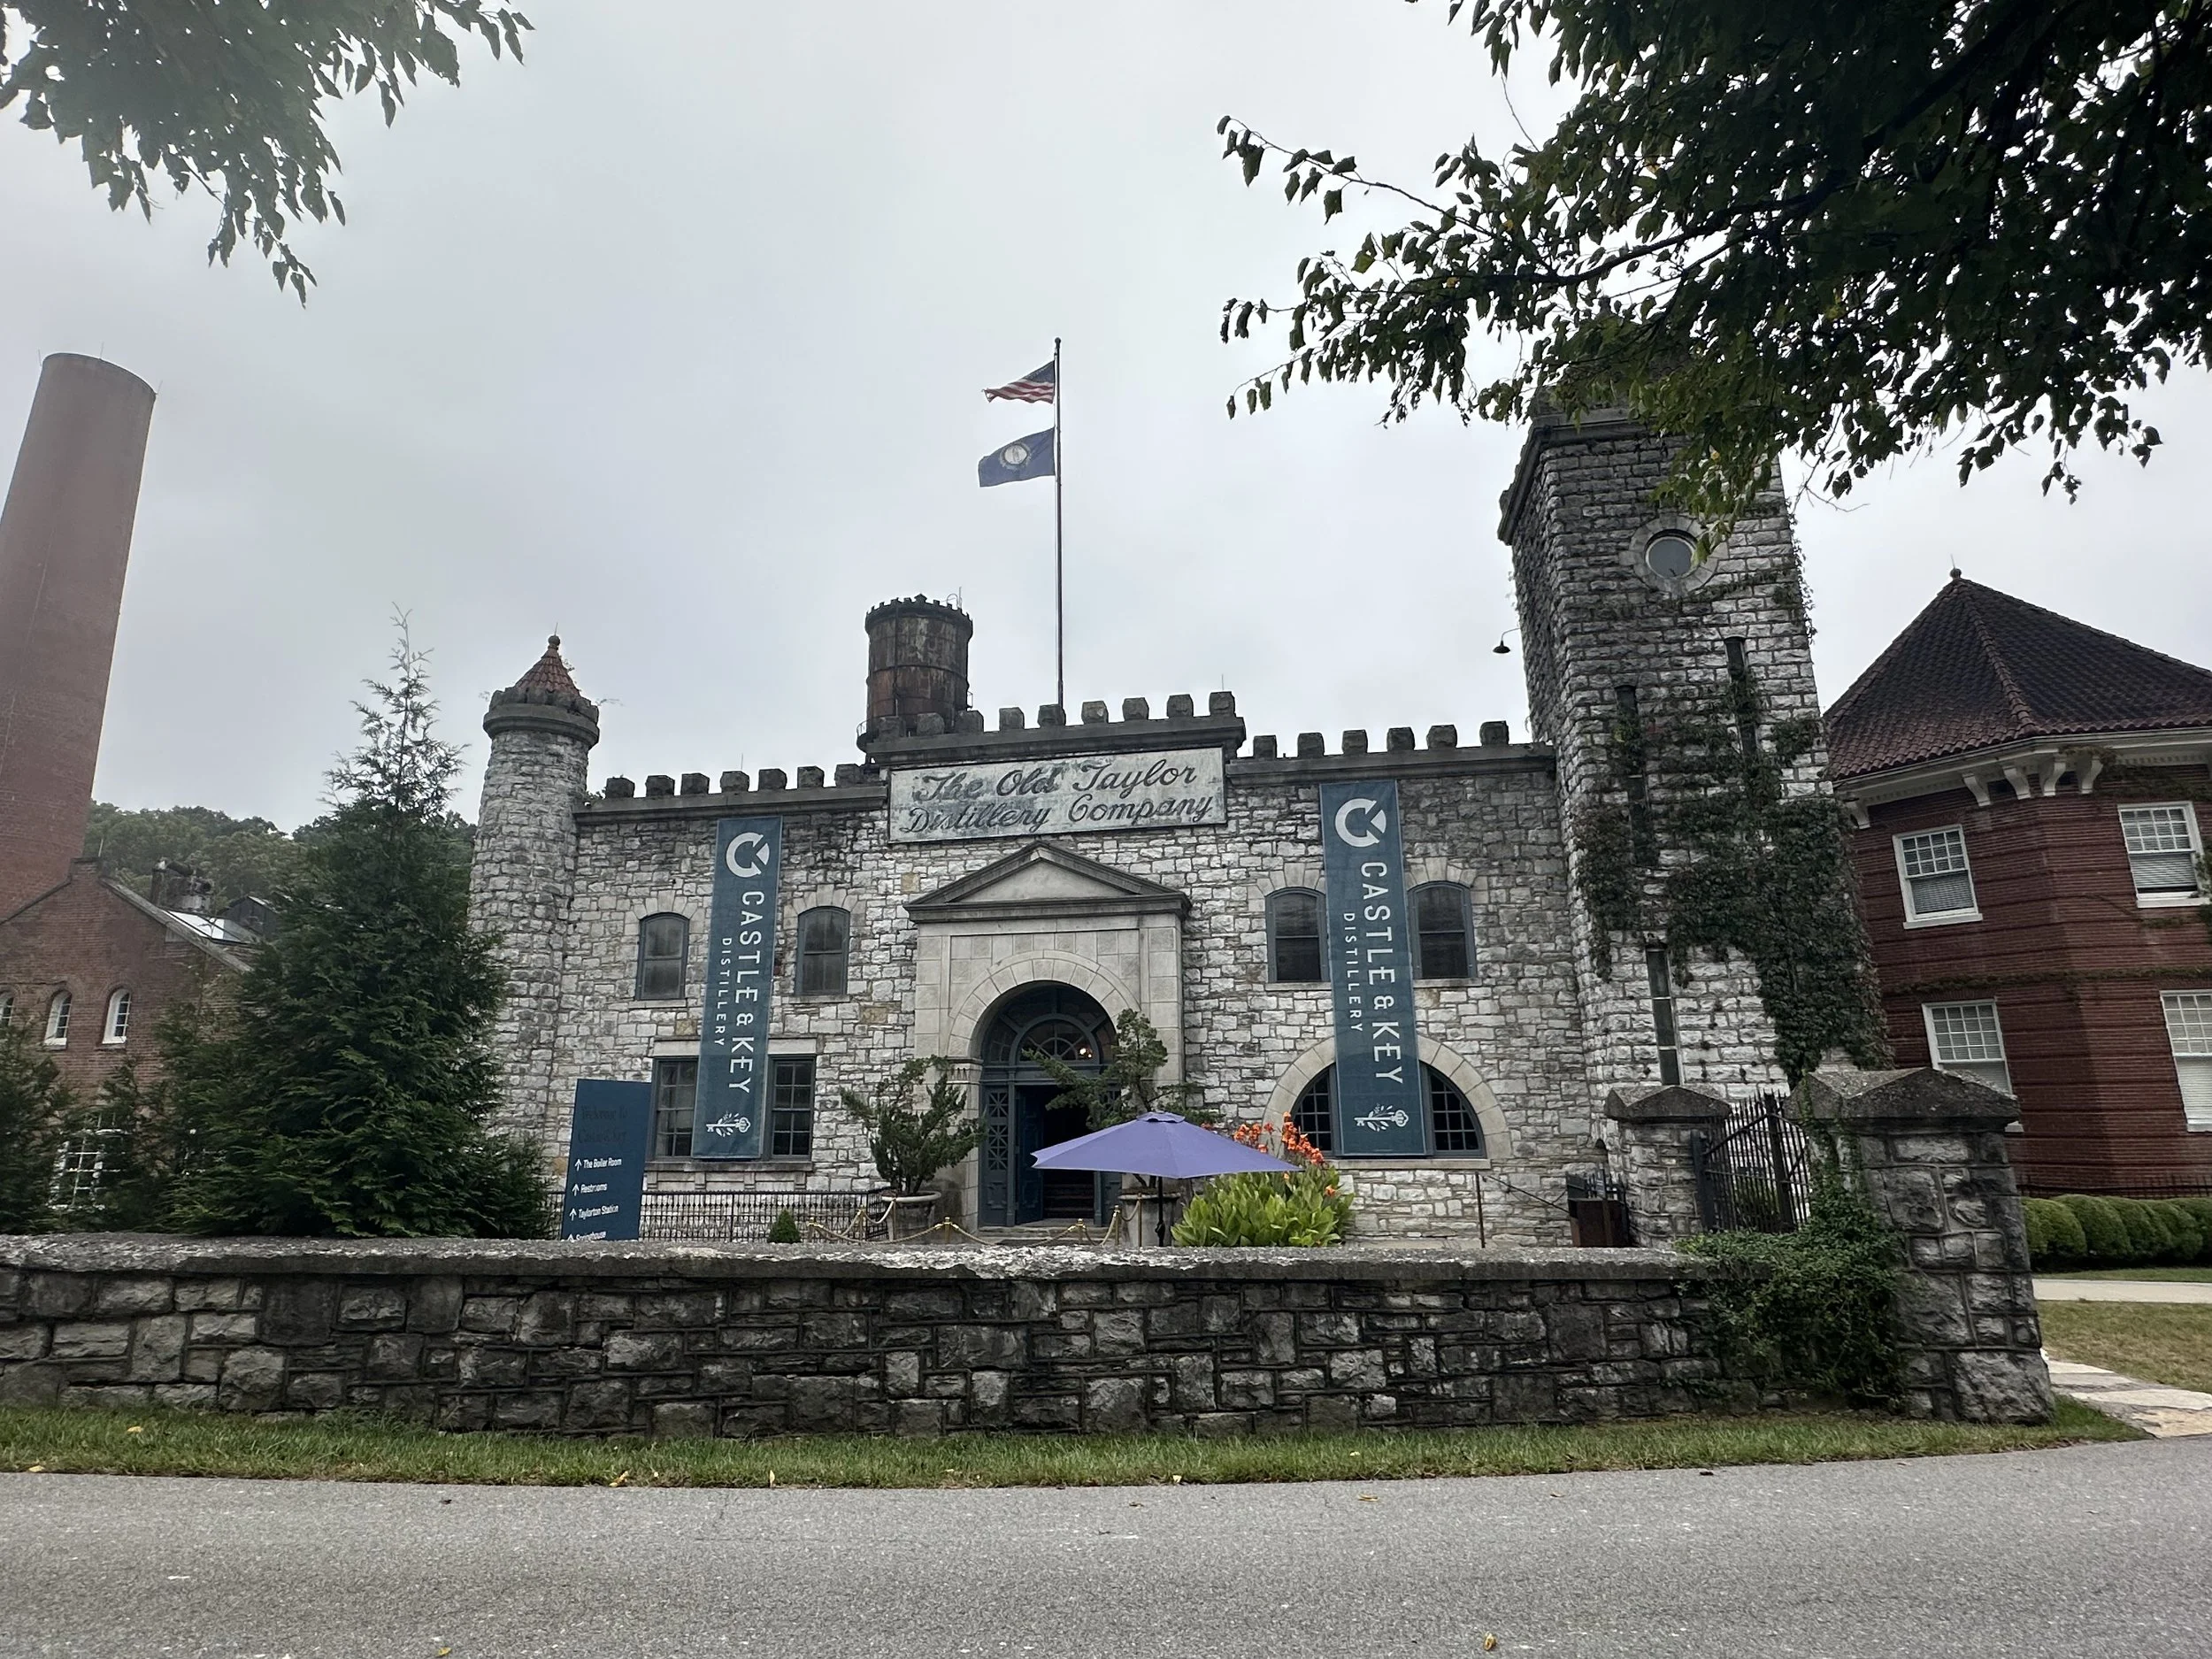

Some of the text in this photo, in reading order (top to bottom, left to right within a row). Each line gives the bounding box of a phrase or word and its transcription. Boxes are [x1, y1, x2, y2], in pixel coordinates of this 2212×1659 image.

[912, 758, 1197, 801] The Old Taylor
[899, 793, 1213, 833] Distillery Company
[714, 937, 733, 1047] DISTILLERY
[728, 891, 764, 1094] CASTLE & KEY
[1342, 911, 1363, 1033] DISTILLERY
[1361, 861, 1405, 1085] CASTLE & KEY
[583, 1157, 622, 1169] The Boiler Room
[580, 1183, 608, 1194] Restrooms
[601, 1204, 619, 1215] Station
